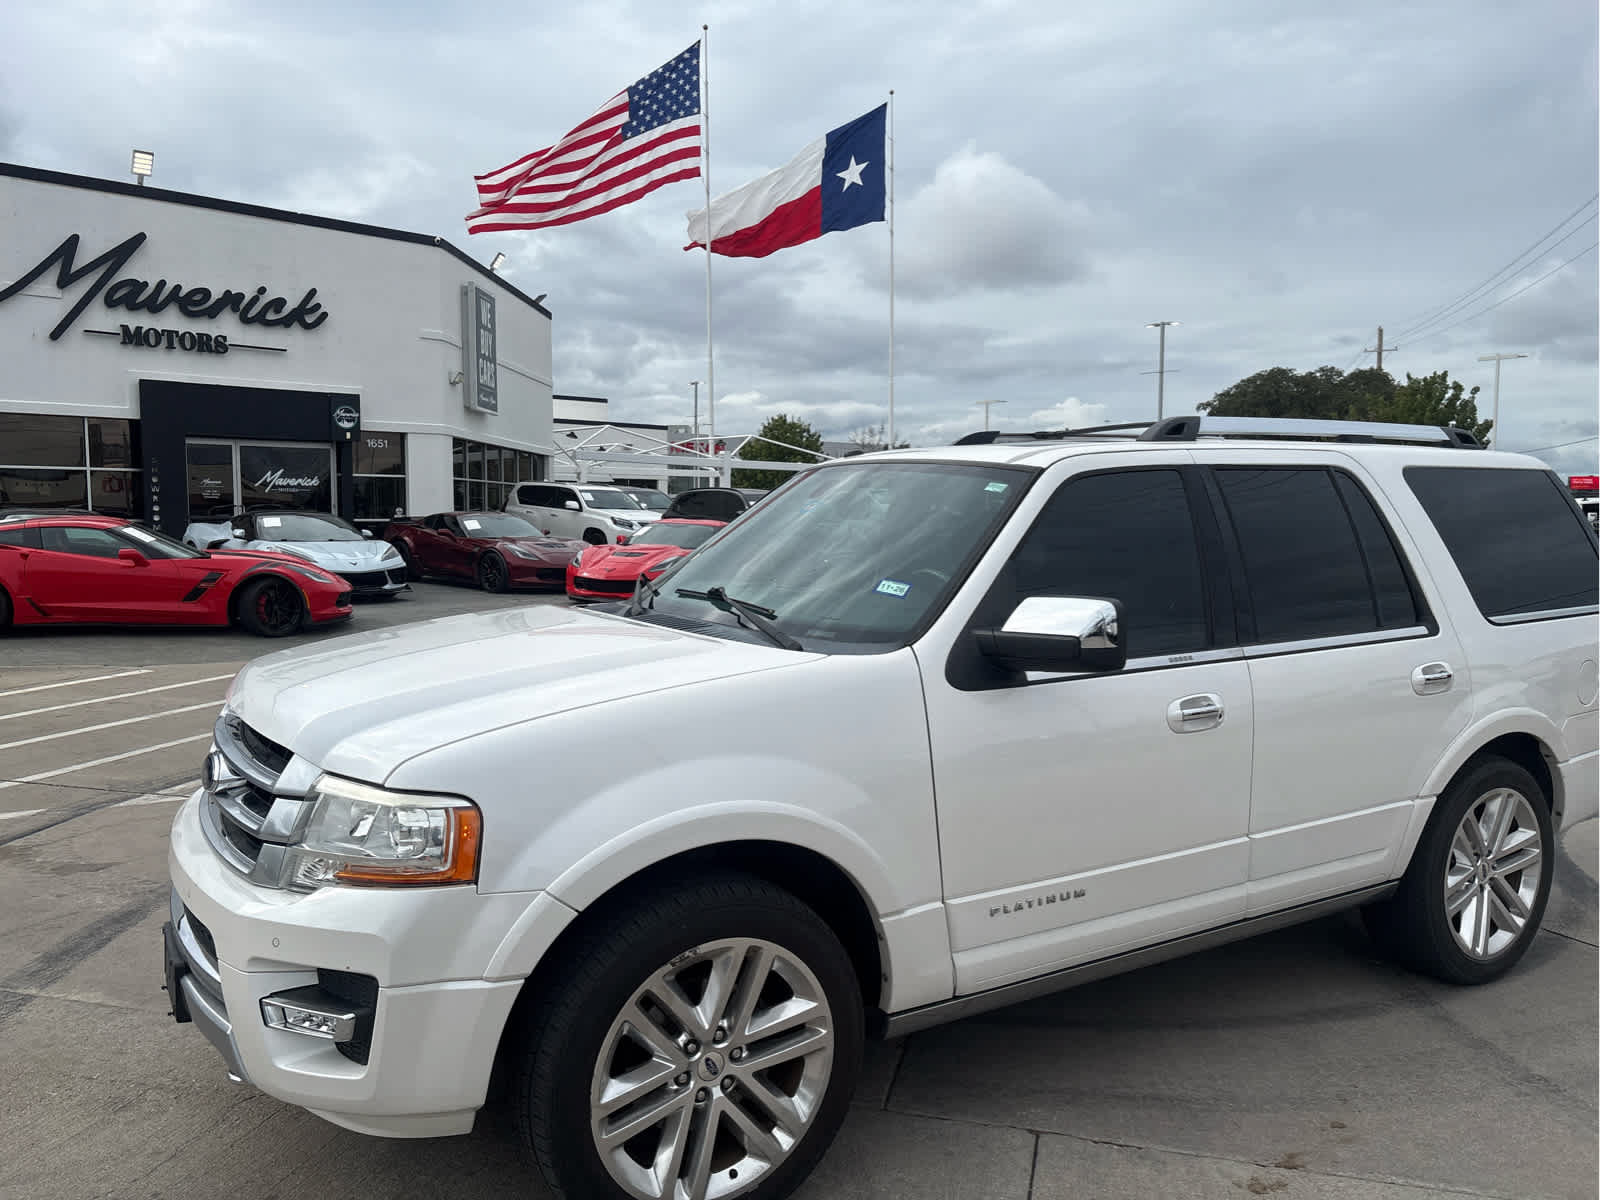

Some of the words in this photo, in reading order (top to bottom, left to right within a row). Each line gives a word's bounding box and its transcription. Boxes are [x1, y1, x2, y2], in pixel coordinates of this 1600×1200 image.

[0, 232, 328, 340] Maverick
[480, 298, 492, 329] WE
[120, 324, 229, 354] MOTORS
[480, 328, 493, 360] BUY
[479, 358, 496, 389] CARS
[366, 438, 388, 449] 1651
[254, 468, 321, 493] Maverick
[989, 888, 1088, 918] PLATINUM
